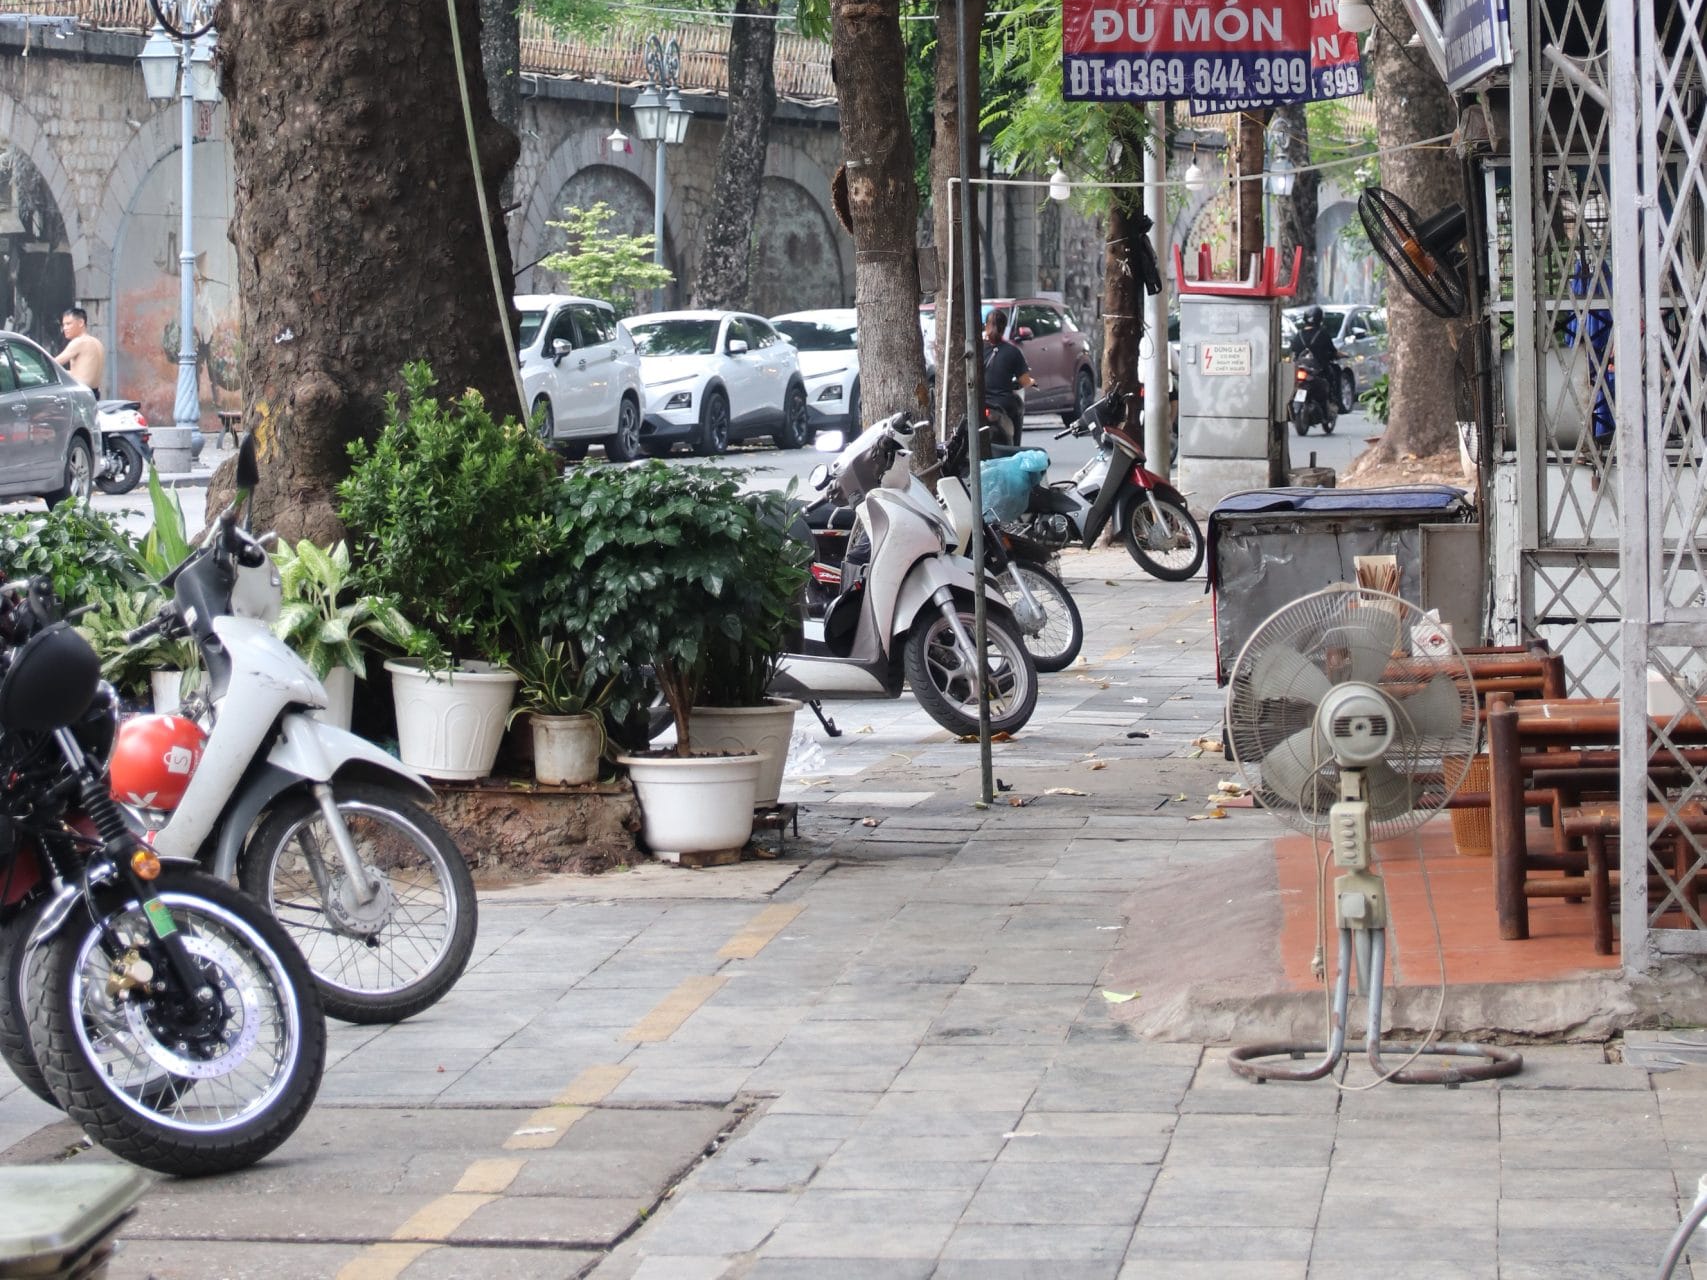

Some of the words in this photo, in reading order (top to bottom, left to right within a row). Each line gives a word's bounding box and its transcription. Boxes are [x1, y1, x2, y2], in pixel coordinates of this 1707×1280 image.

[1194, 57, 1246, 95] 644
[1255, 57, 1307, 95] 399
[1322, 66, 1359, 97] 399
